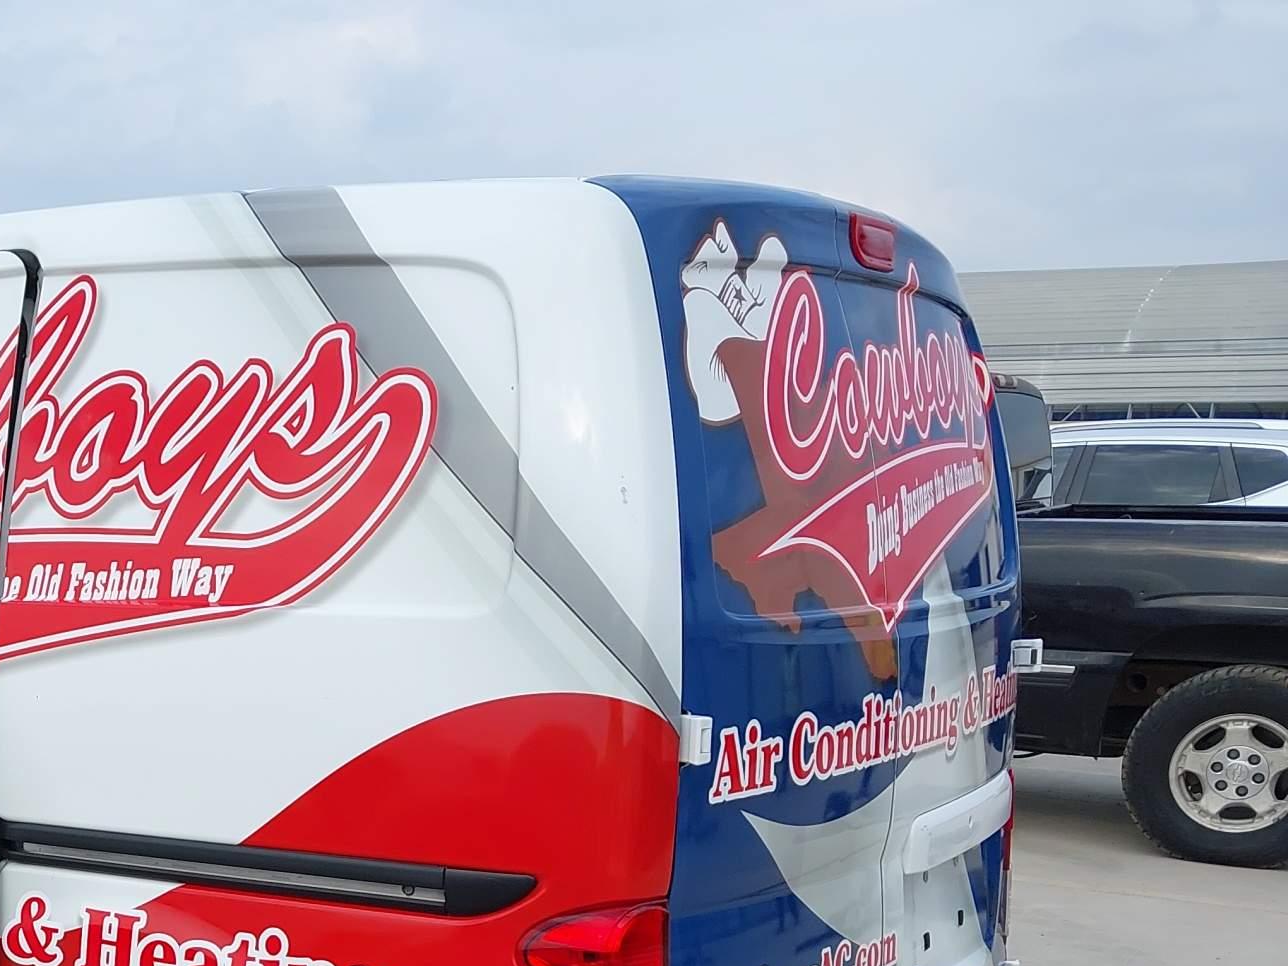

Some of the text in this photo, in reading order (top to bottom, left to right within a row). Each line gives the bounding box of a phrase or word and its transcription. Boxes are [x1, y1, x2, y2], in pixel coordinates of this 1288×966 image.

[866, 492, 901, 576] Doing
[900, 477, 935, 536] Business
[23, 561, 63, 602] Old
[64, 561, 160, 602] Fashion
[170, 557, 234, 603] Way
[709, 718, 782, 804] Air
[789, 690, 961, 787] Conditioning
[962, 670, 980, 735] &
